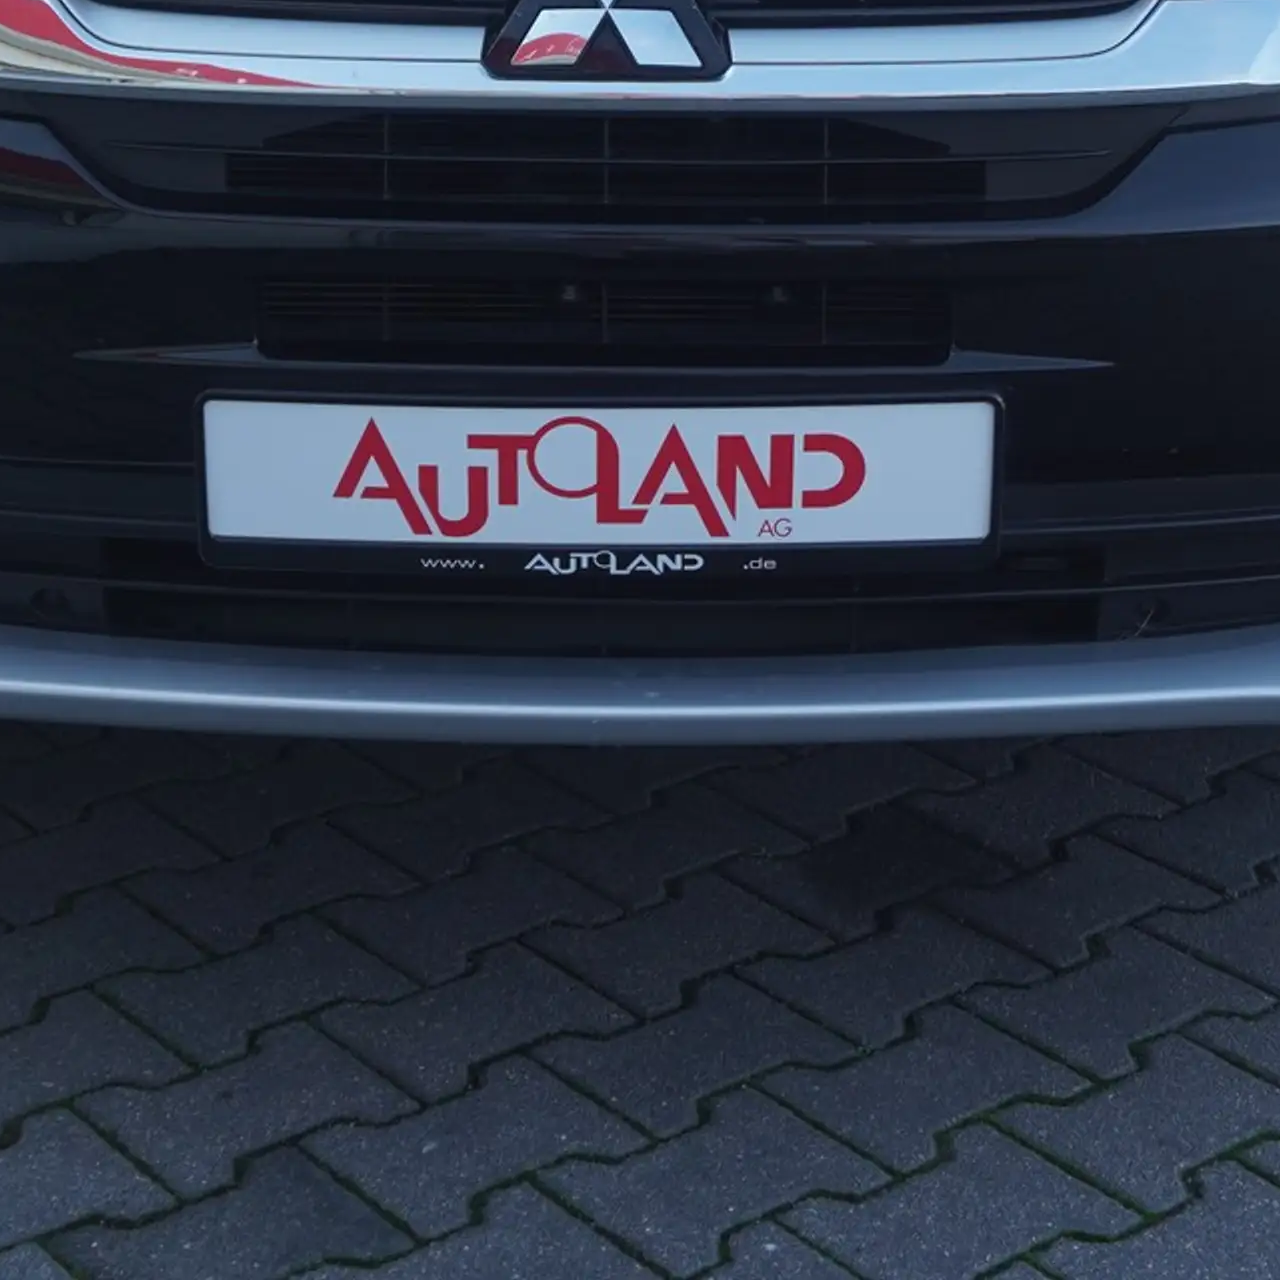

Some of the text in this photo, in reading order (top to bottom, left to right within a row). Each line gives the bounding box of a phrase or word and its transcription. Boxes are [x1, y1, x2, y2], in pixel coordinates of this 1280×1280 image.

[332, 415, 867, 538] AUTOLAND
[757, 517, 793, 538] AG
[420, 550, 778, 576] www. AUTOLAND .de
